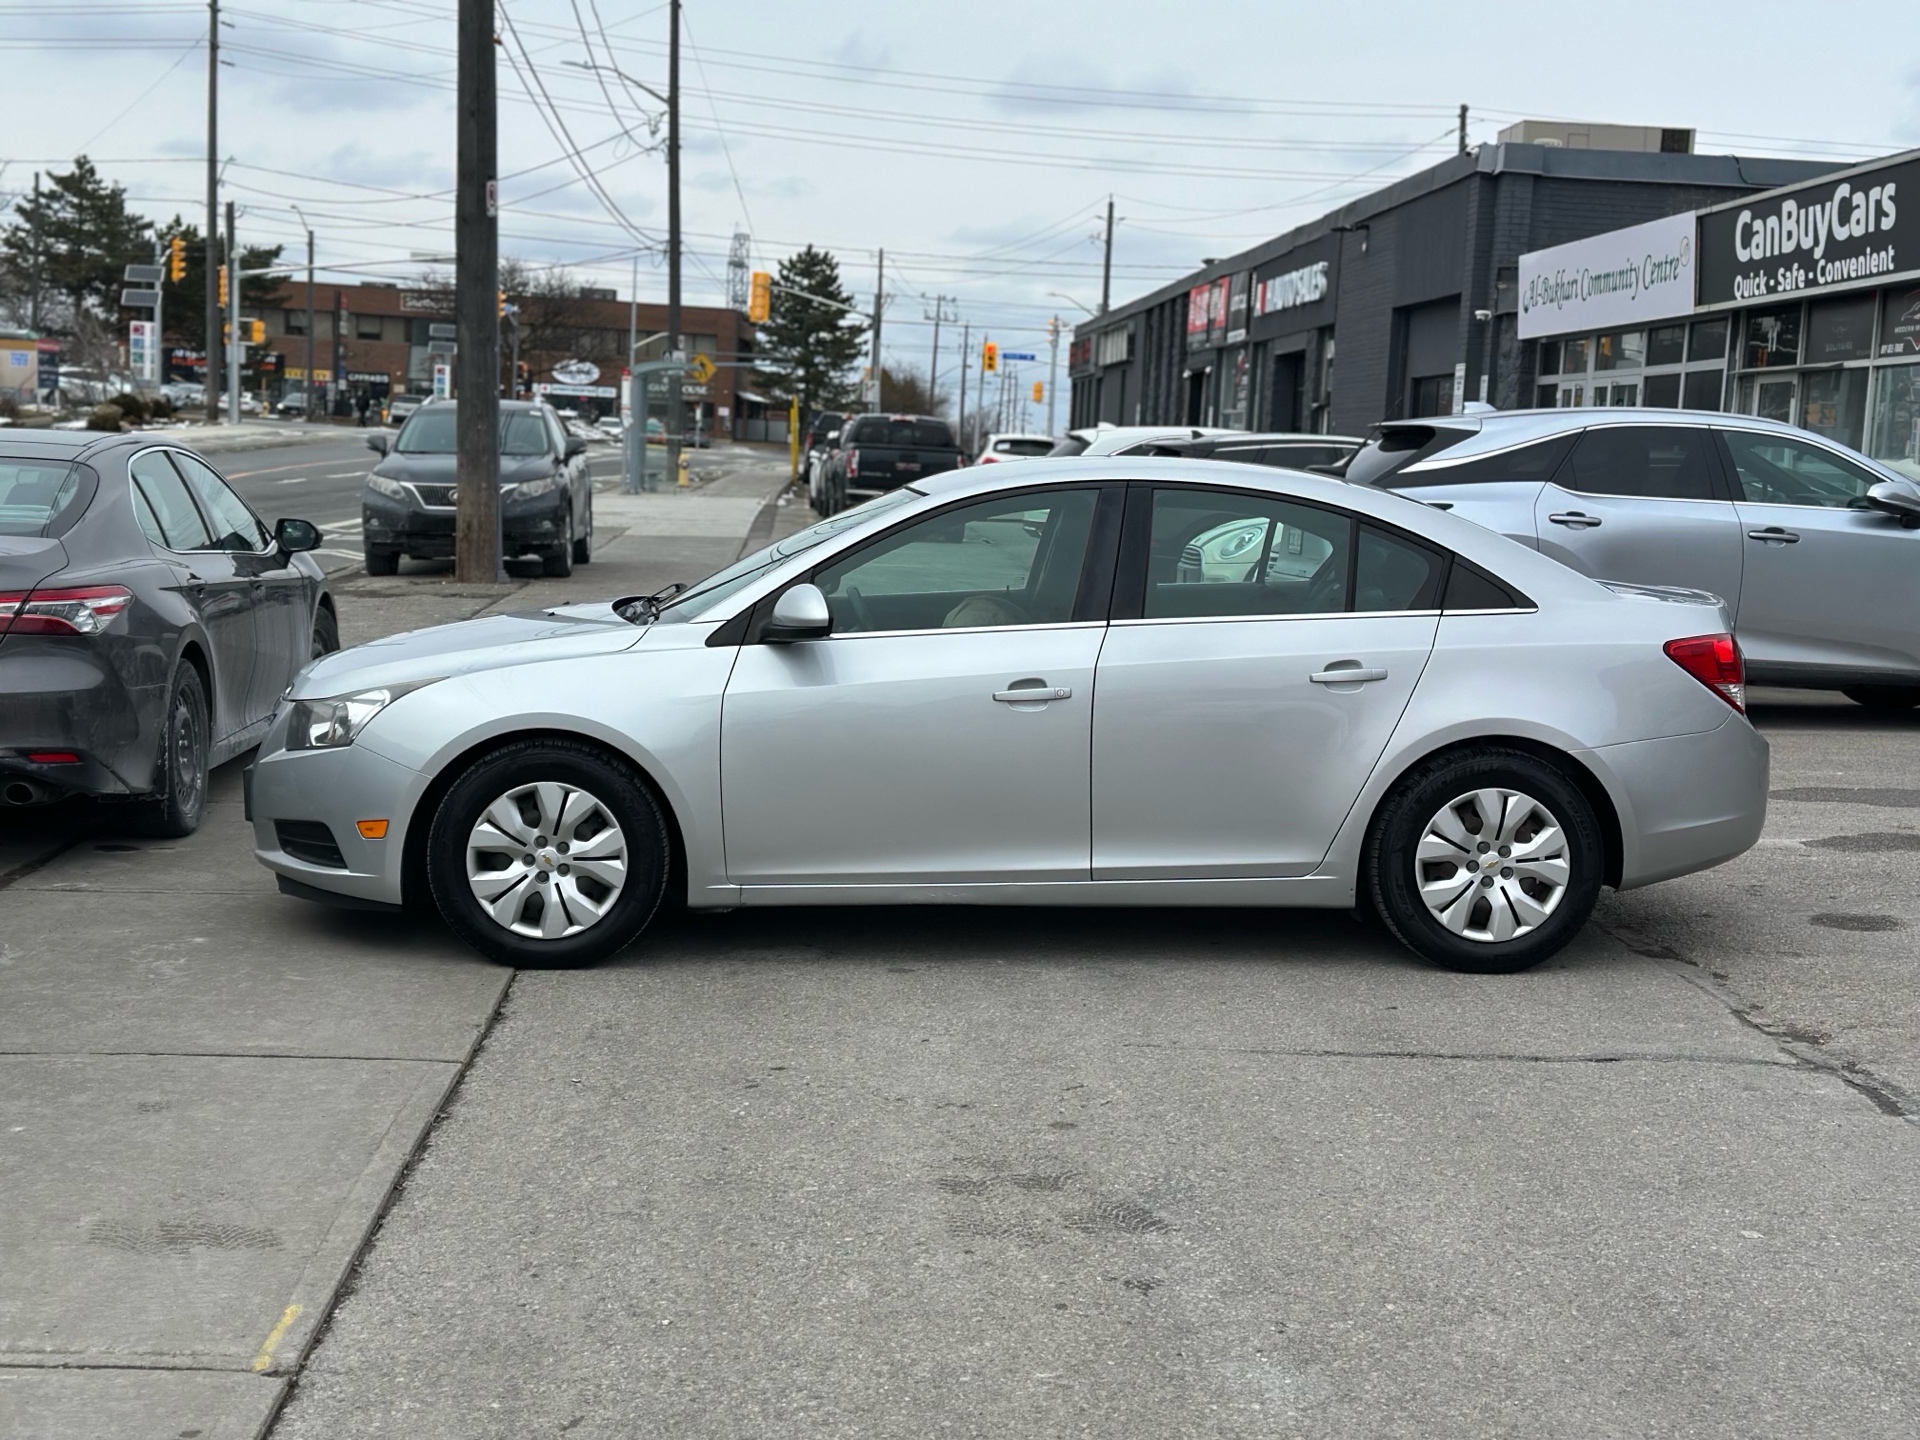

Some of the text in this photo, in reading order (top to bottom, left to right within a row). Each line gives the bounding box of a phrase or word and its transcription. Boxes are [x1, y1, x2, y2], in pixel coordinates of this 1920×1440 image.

[1735, 183, 1896, 262] CanBuyCars
[1522, 254, 1680, 314] Al-Bukhari Community Centre
[1734, 270, 1767, 300] Quick
[1777, 263, 1805, 292] Safe
[1816, 245, 1895, 284] Convenient
